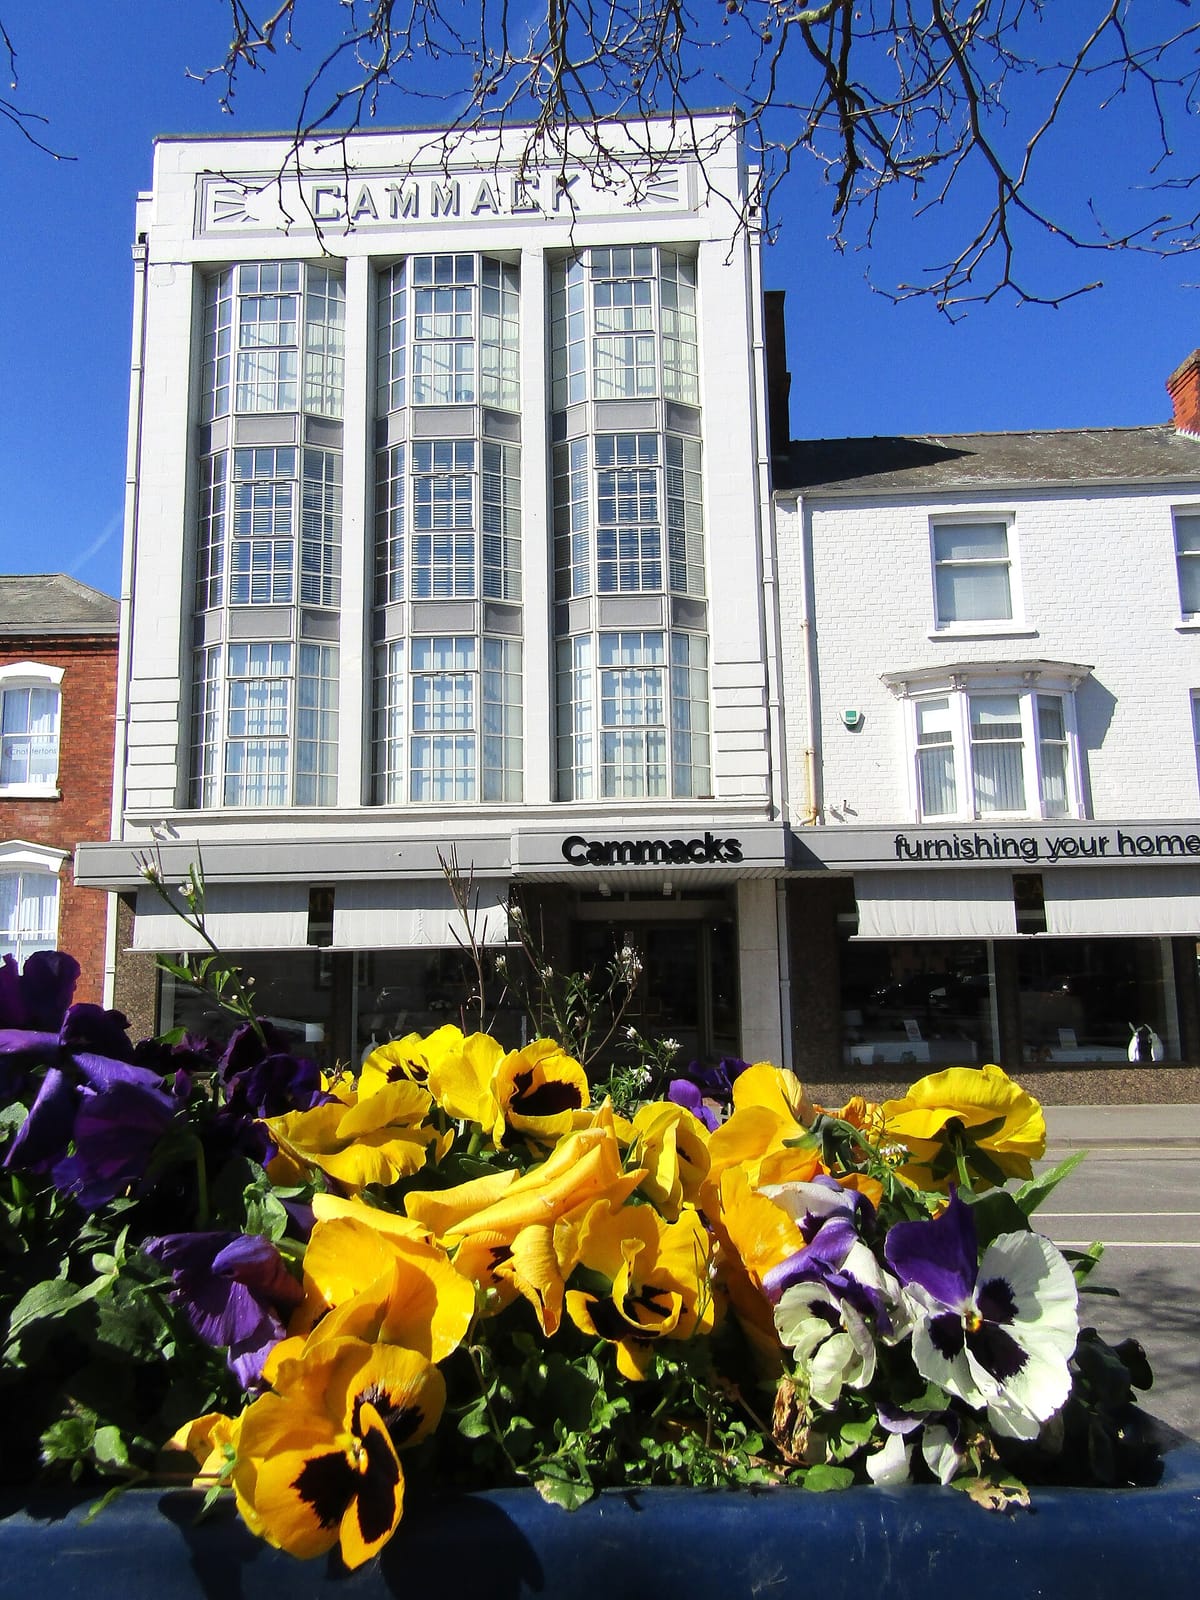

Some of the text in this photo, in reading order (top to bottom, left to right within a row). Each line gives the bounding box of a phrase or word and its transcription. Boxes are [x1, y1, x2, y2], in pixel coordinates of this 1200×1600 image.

[311, 173, 581, 223] CAMMACK
[562, 831, 744, 867] Cammacks
[894, 829, 1200, 864] furnishing your home
